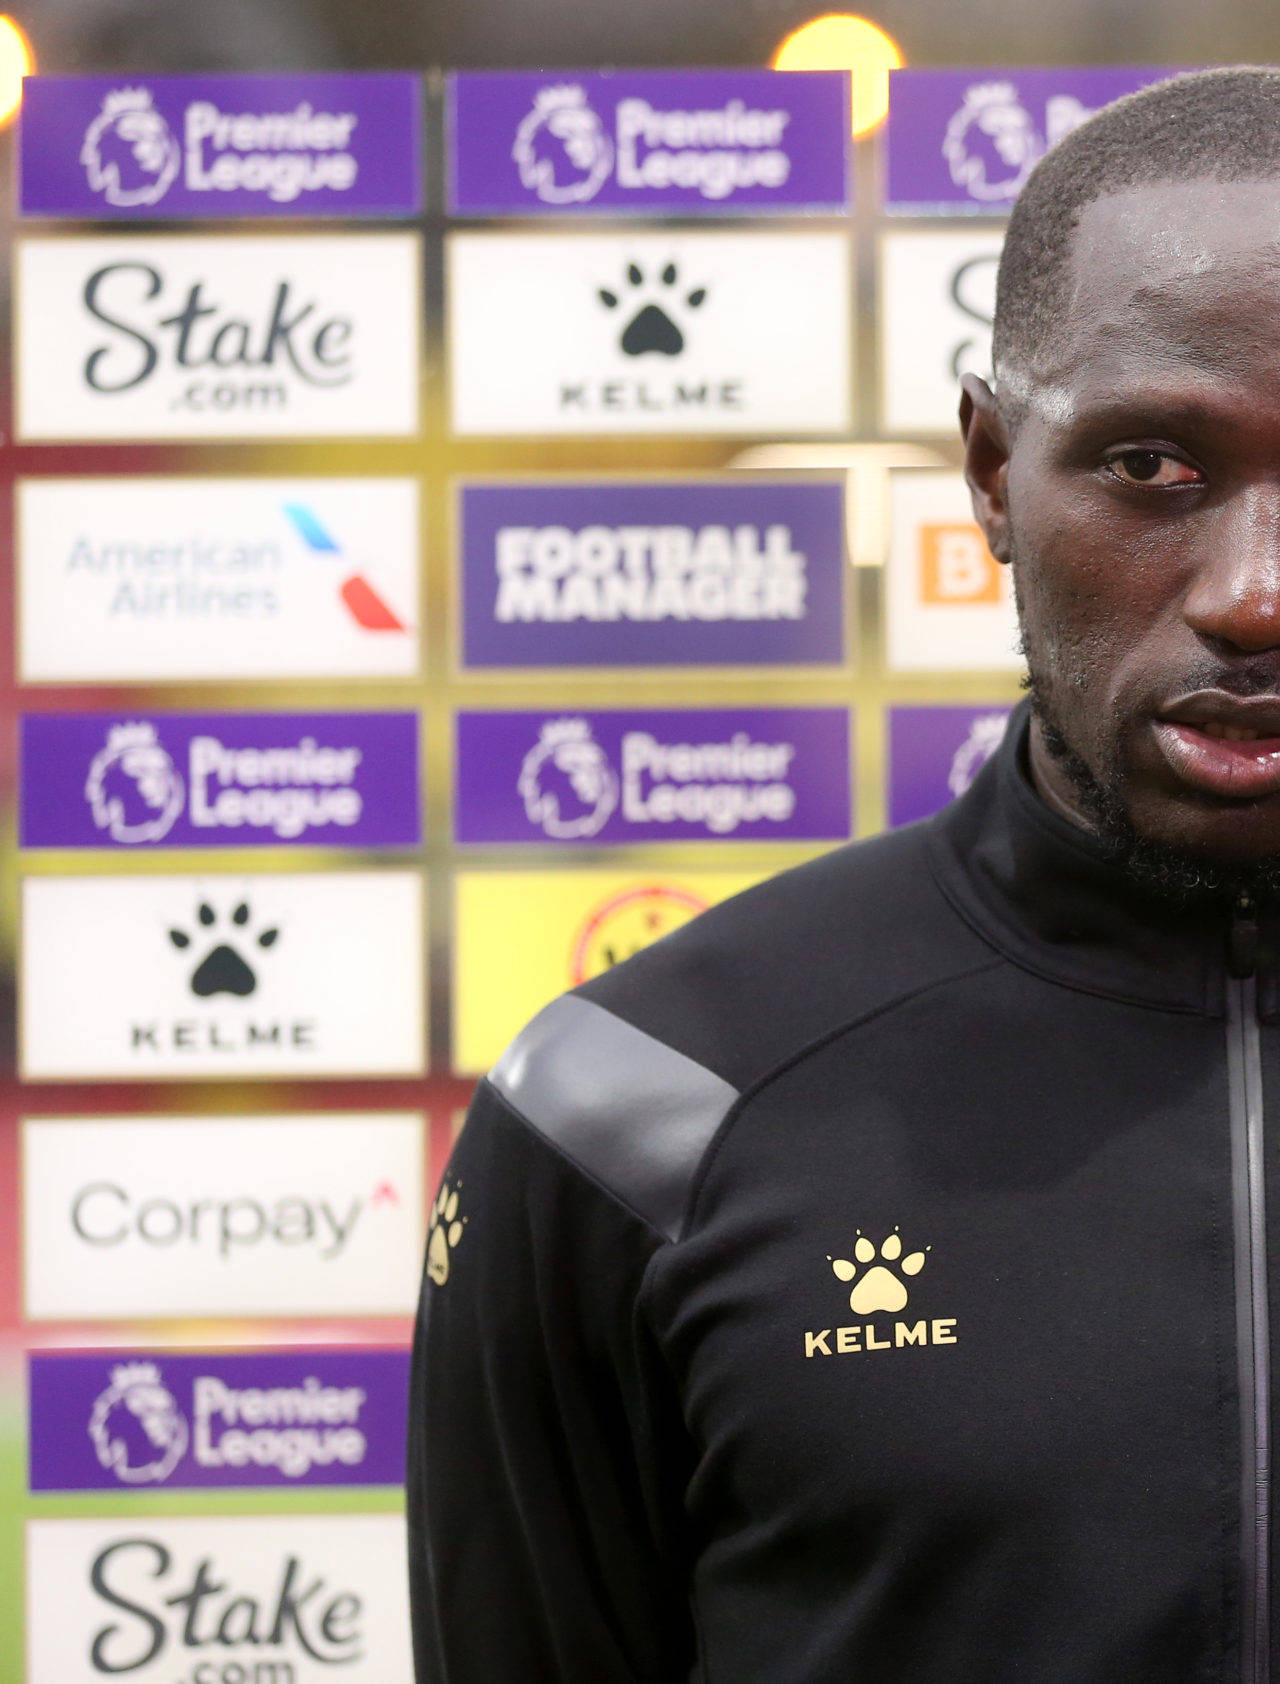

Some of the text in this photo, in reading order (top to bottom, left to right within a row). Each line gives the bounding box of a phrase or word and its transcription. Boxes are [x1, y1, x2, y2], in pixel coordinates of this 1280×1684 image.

[185, 103, 355, 149] Premier
[617, 100, 787, 147] Premier
[185, 148, 356, 201] League
[617, 146, 788, 199] League
[83, 261, 352, 394] Stake
[170, 381, 288, 412] .com
[559, 381, 744, 412] KELME
[65, 534, 281, 573] American
[495, 527, 804, 576] FOOTBALL
[109, 580, 280, 619] Airlines
[495, 574, 805, 622] MANAGER
[190, 737, 360, 785] Premier
[622, 732, 793, 779] Premier
[190, 784, 361, 838] League
[622, 778, 794, 833] League
[130, 1022, 319, 1053] KELME
[70, 1183, 364, 1260] Corpay
[804, 1318, 958, 1358] KELME
[194, 1377, 364, 1424] Premier
[194, 1423, 365, 1477] League
[90, 1538, 364, 1673] Stake
